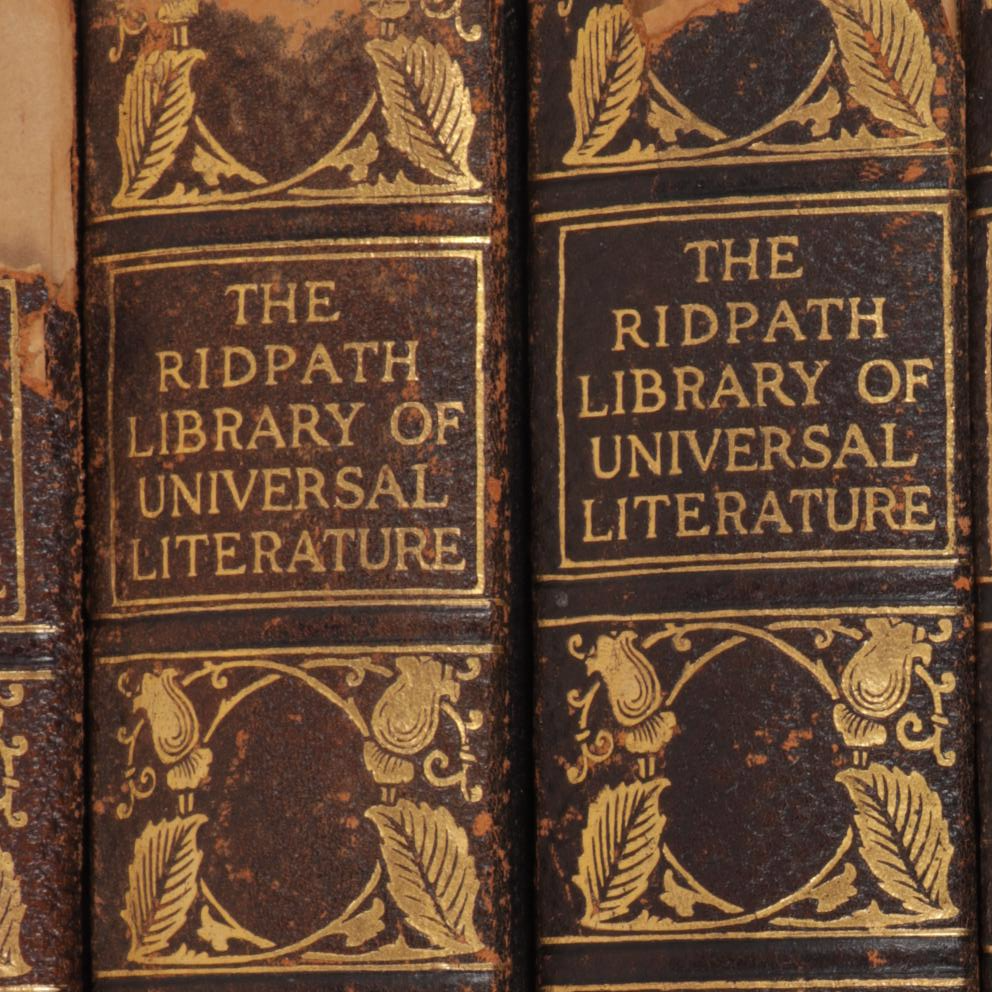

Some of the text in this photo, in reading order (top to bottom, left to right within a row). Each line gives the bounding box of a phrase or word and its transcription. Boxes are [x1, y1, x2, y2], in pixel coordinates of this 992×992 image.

[683, 235, 804, 284] THE
[225, 280, 341, 326] THE
[611, 297, 889, 352] RIDPATH
[155, 340, 420, 393] RIDPATH
[577, 358, 934, 418] LIBRARY OF
[127, 401, 464, 458] LIBRARY OF
[590, 423, 919, 480] UNIVERSAL
[138, 463, 448, 520] UNIVERSAL
[582, 485, 937, 543] LITERATURE
[131, 527, 466, 581] LITERATURE
